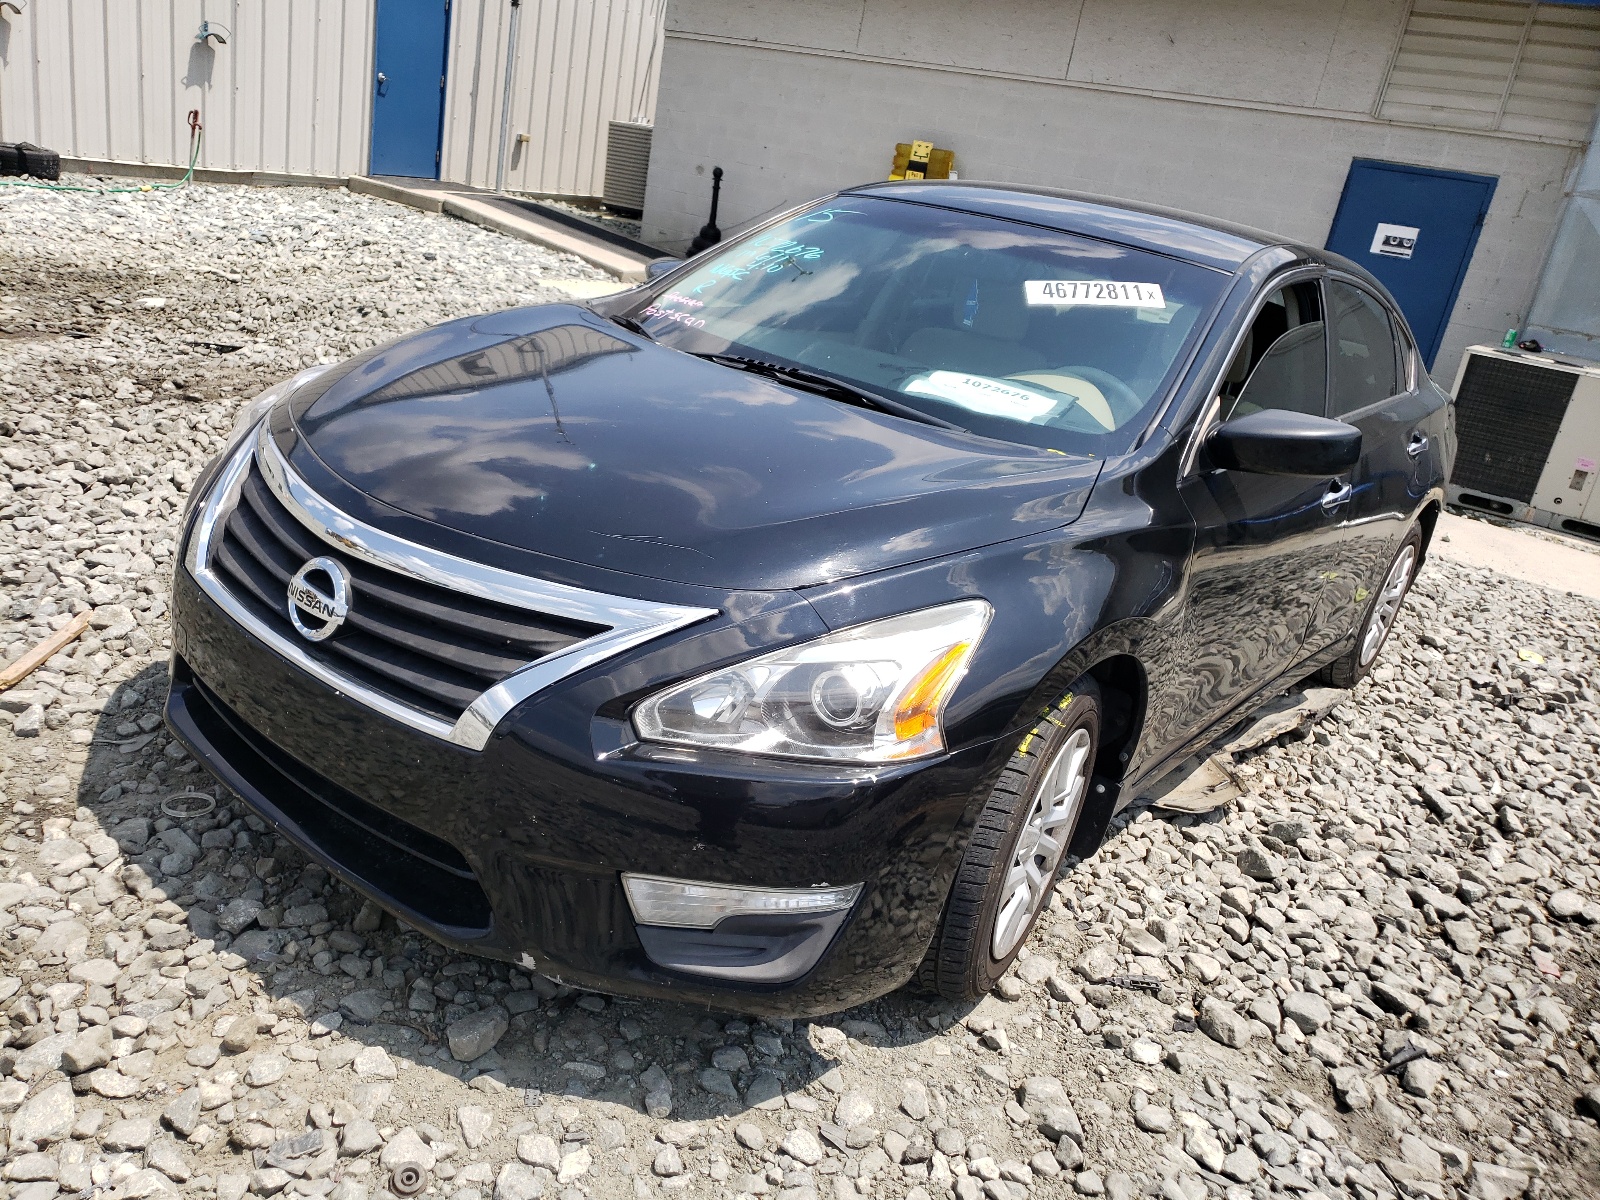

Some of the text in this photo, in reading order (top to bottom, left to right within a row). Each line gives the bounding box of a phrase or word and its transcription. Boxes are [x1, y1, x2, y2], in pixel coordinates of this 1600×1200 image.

[1042, 282, 1143, 300] 46772811
[962, 378, 1030, 401] 1072676
[288, 582, 336, 618] NISSAN
